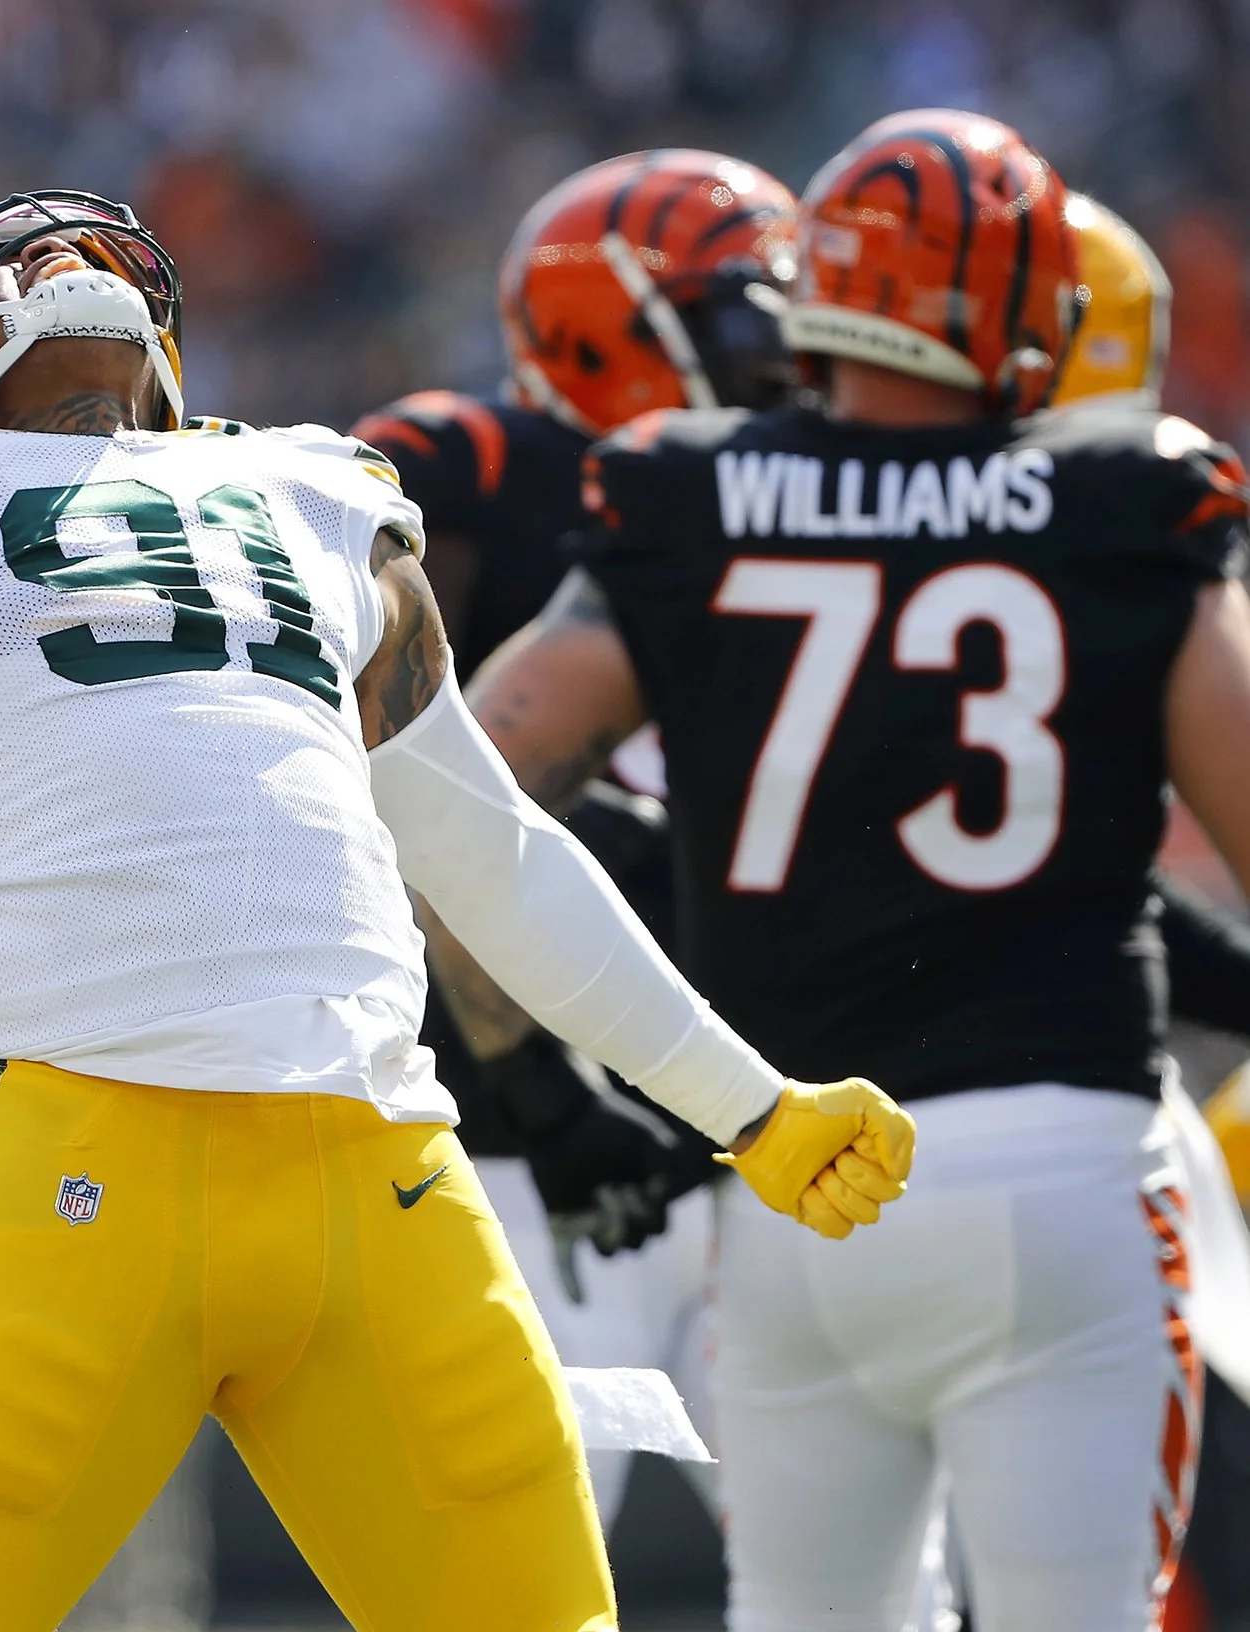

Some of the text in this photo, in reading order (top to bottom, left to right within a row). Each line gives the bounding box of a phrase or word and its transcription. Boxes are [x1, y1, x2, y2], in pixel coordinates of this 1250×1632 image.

[716, 449, 1054, 538] WILLIAMS
[711, 555, 1067, 893] 73
[62, 1194, 91, 1217] NFL
